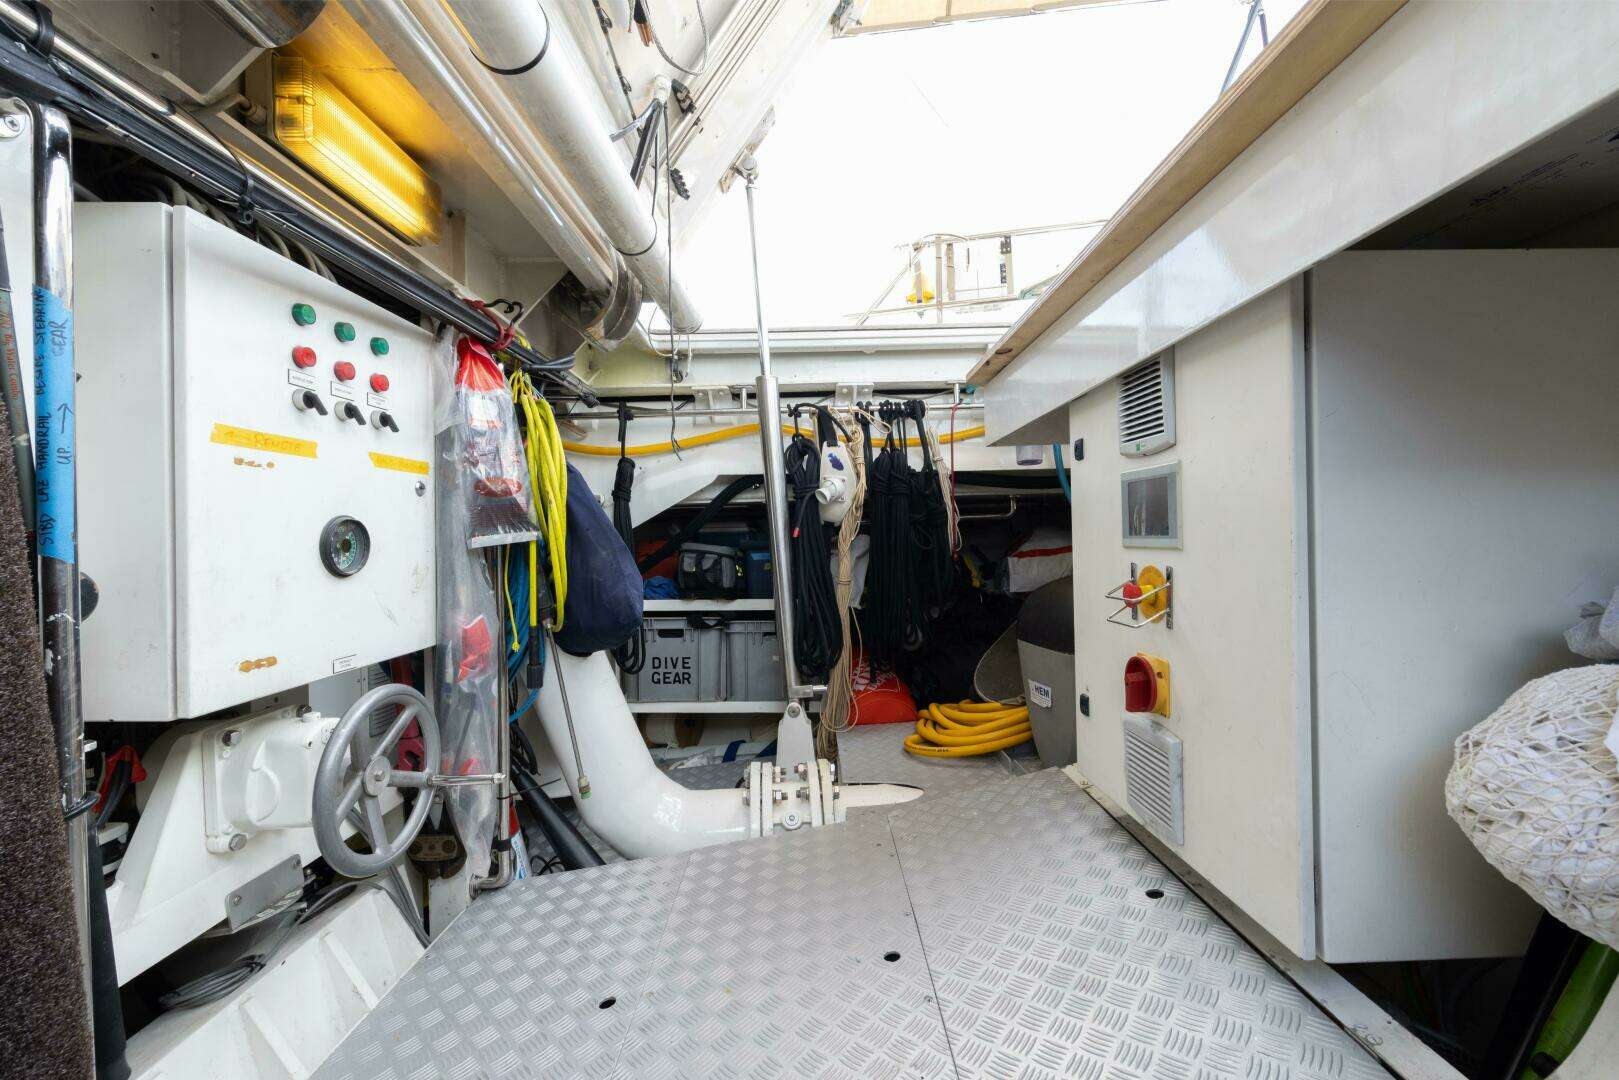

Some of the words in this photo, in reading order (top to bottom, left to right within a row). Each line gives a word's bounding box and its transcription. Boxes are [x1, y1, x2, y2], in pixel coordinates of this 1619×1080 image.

[48, 319, 68, 357] GEAR
[37, 412, 52, 470] HANDRAIL
[39, 513, 56, 546] STBD
[651, 671, 691, 685] GEAR
[652, 656, 691, 670] DIVE
